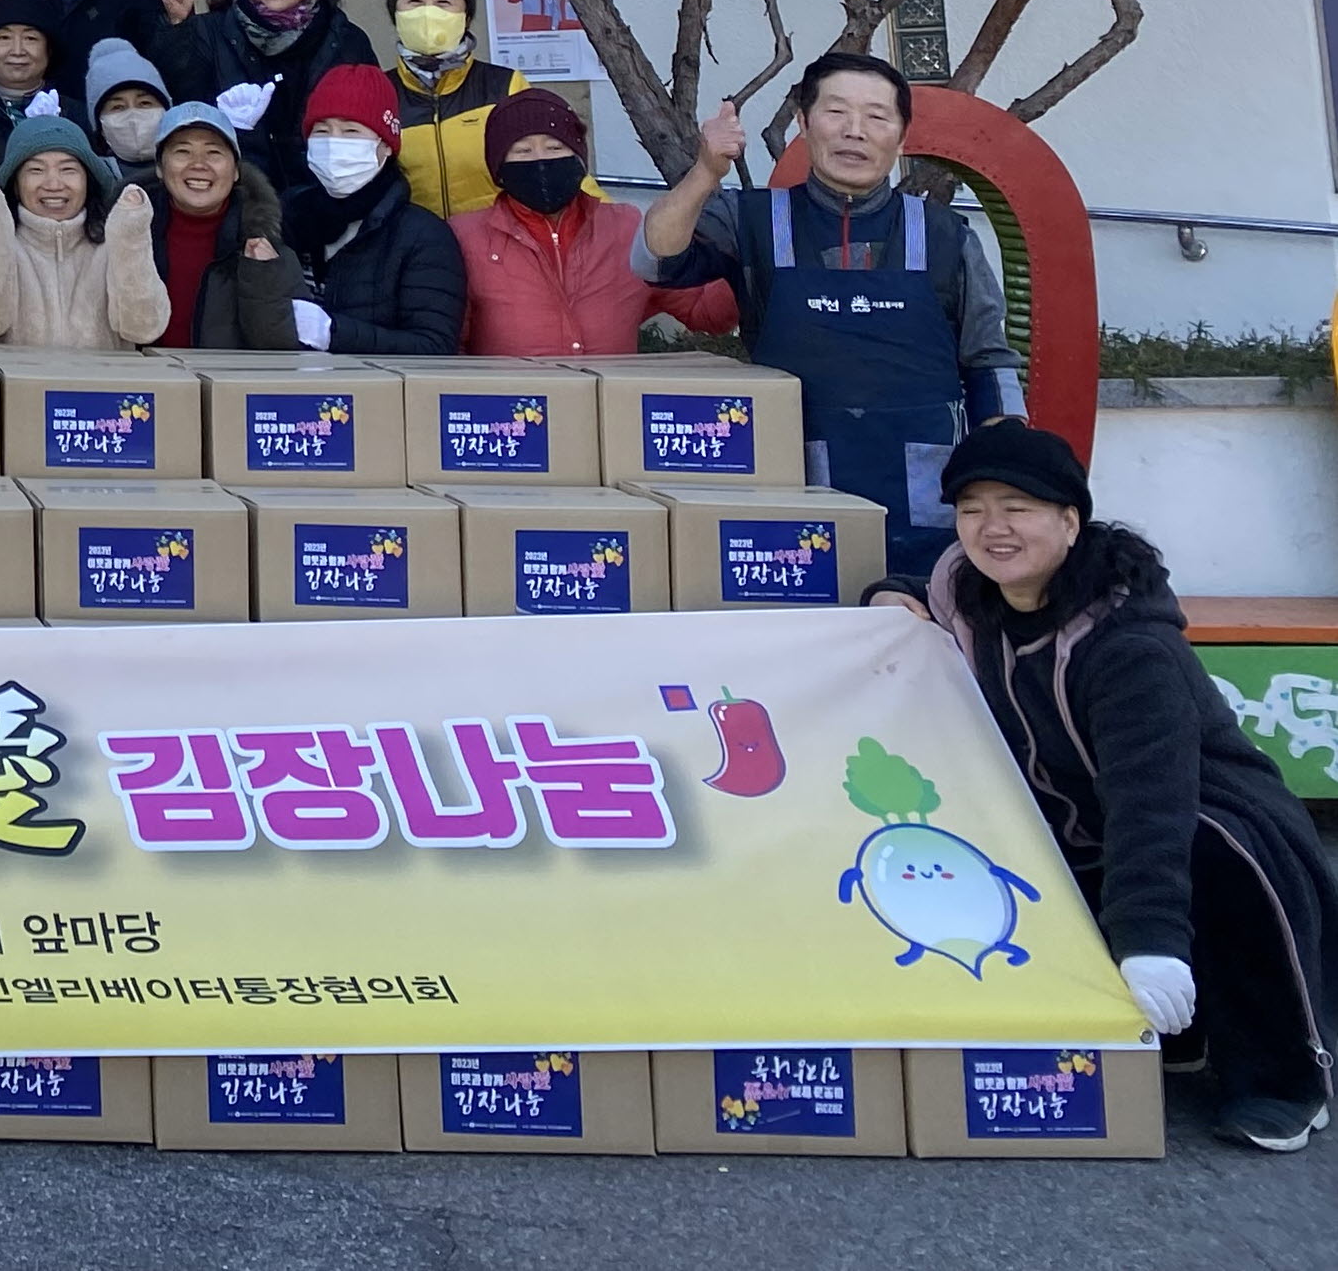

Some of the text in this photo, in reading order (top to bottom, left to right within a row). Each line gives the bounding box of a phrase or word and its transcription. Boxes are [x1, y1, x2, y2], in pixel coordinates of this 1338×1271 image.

[56, 432, 126, 453] 김장나눔
[257, 435, 326, 456] 김장나눔
[451, 435, 520, 456] 김장나눔
[654, 436, 724, 457] 김장나눔
[90, 571, 164, 592] 김장나눔
[305, 568, 378, 591] 김장나눔
[732, 564, 806, 586] 김장나눔
[526, 577, 599, 598] 김장나눔
[100, 718, 674, 849] 김장나눔
[23, 911, 161, 955] 앞마당
[452, 1058, 480, 1069] 2023년
[221, 1077, 308, 1105] 김장나눔
[454, 1088, 545, 1117] 김장나눔
[979, 1092, 1067, 1121] 김장나눔
